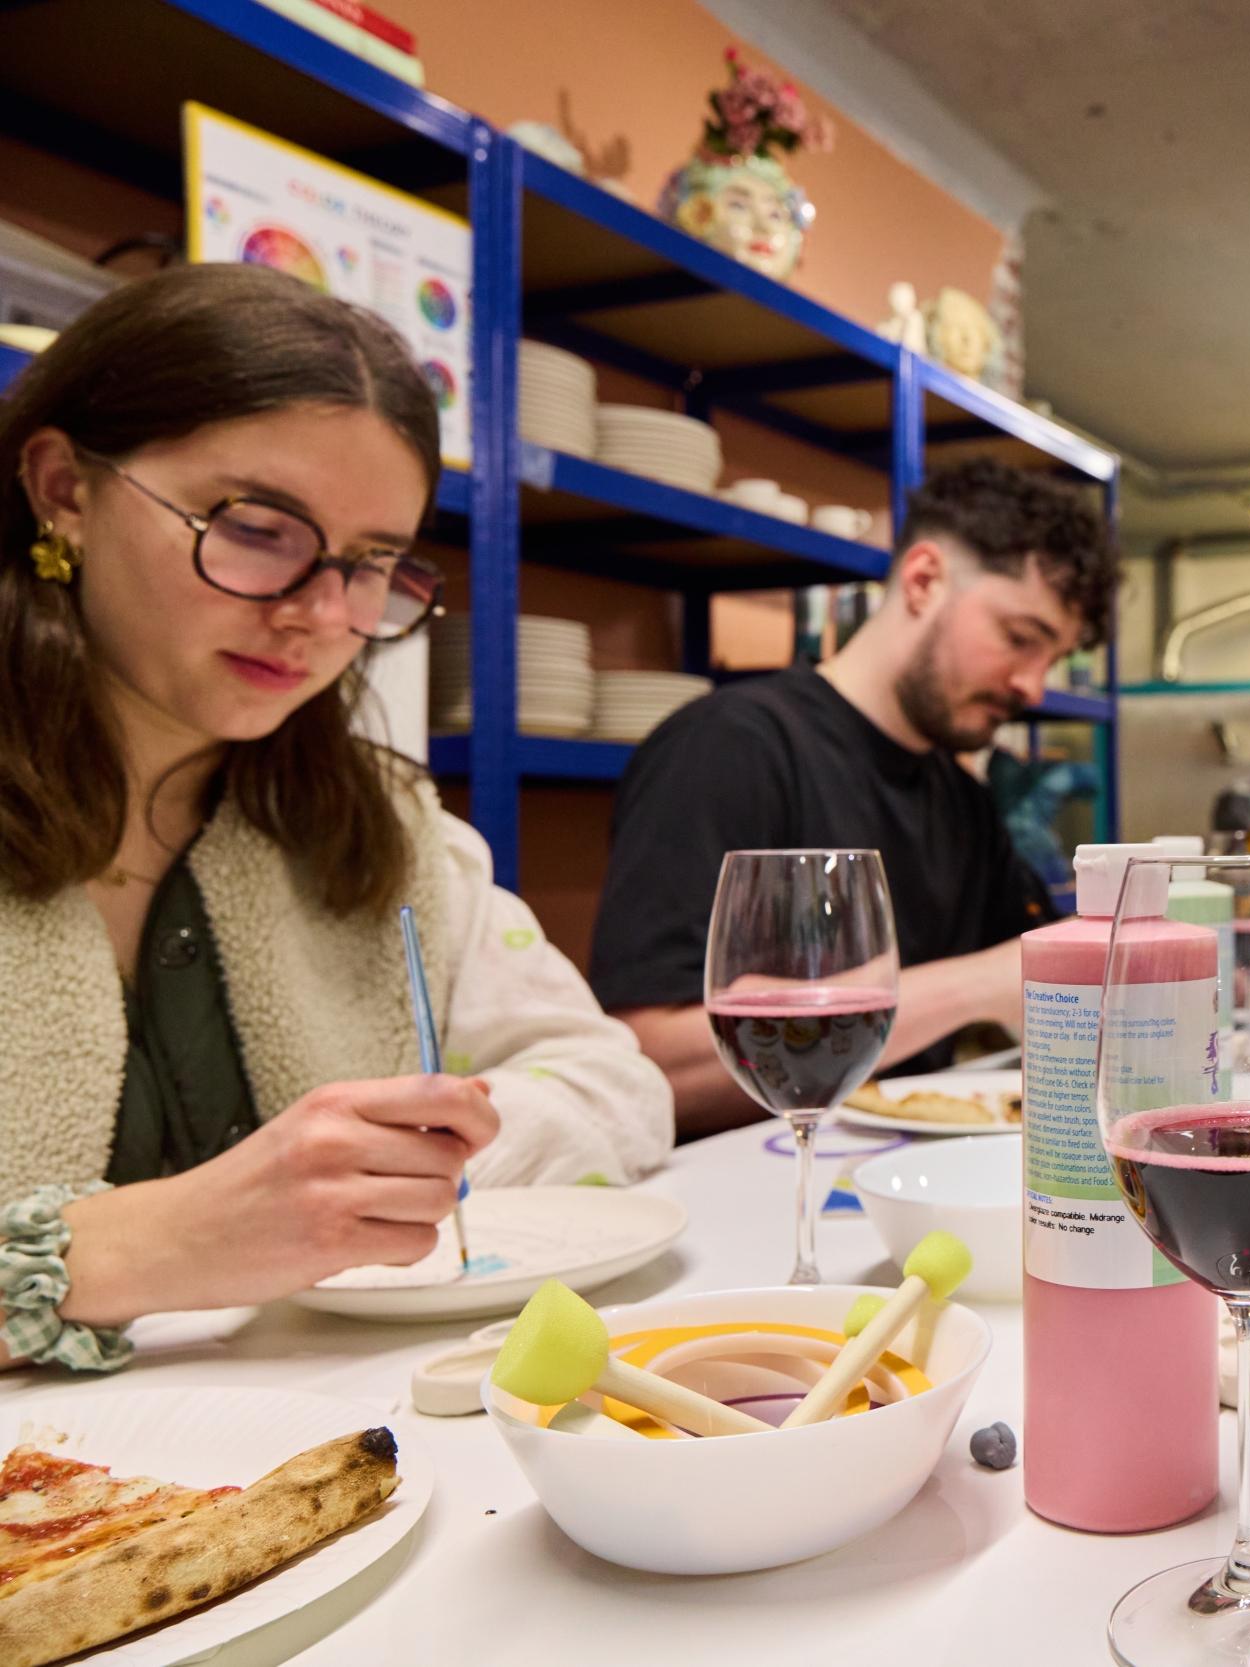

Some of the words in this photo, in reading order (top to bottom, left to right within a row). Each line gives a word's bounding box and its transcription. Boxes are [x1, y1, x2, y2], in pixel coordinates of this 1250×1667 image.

[1055, 993, 1079, 1003] Choice
[1072, 1008, 1082, 1017] 2-3
[1083, 1008, 1092, 1017] for
[1065, 1020, 1077, 1028] Will
[1077, 1021, 1087, 1029] not
[1069, 1067, 1091, 1077] without
[1071, 1080, 1088, 1088] Check
[1093, 1177, 1107, 1185] Food
[1089, 1212, 1125, 1224] Midrange
[1058, 1222, 1068, 1232] No
[1069, 1224, 1095, 1236] change
